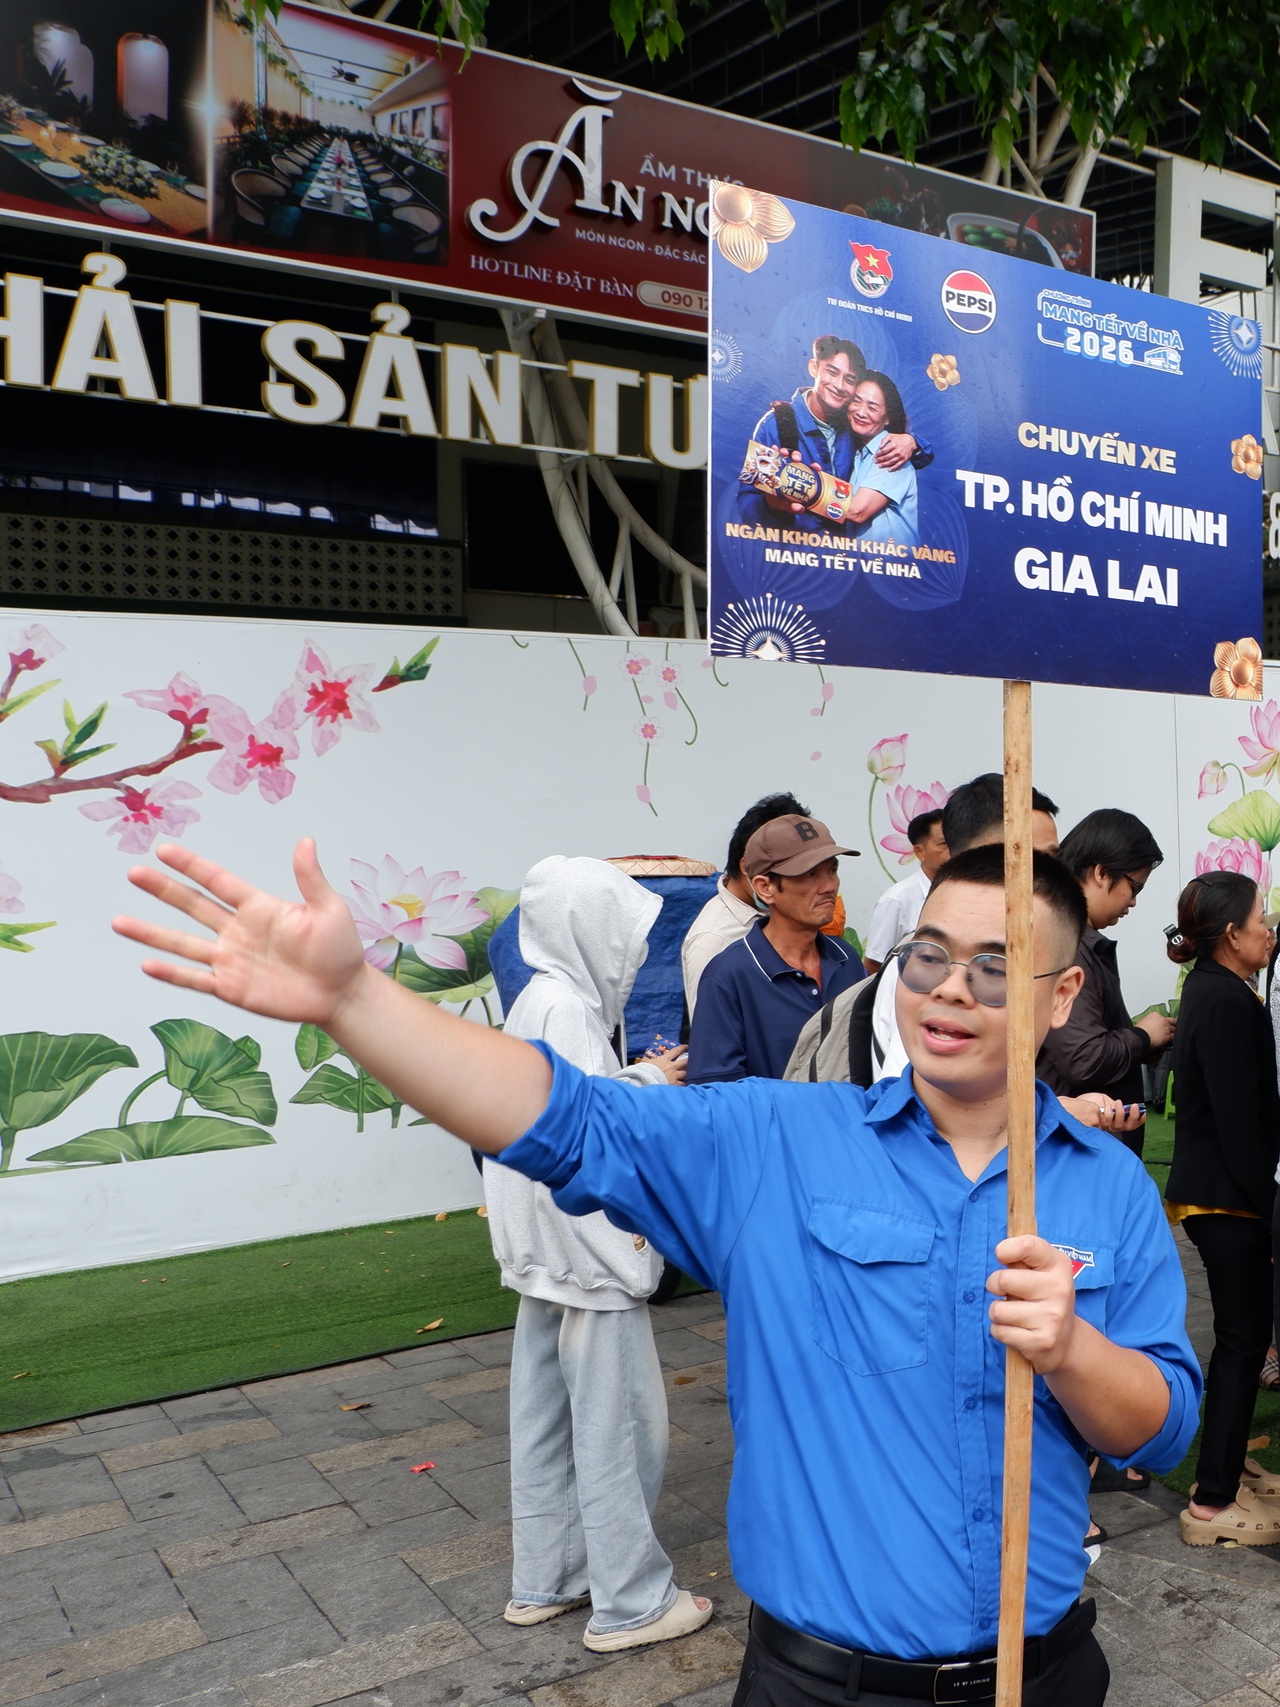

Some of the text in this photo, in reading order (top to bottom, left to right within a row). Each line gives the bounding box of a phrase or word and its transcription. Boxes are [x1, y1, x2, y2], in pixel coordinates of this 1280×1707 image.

[640, 153, 676, 182] ẨM
[608, 234, 645, 252] NGON
[470, 254, 634, 298] HOTLINE ĐẶT BÀN
[661, 290, 693, 308] 090
[945, 290, 993, 313] PEPSI
[1043, 302, 1184, 350] MANG TẾT VỀ NHÀ
[1064, 326, 1134, 367] 2026
[260, 301, 522, 447] SẢN
[1017, 421, 1177, 475] CHUYẾN XE
[787, 465, 815, 484] MANG
[787, 476, 811, 493] TẾT
[955, 469, 1228, 547] TP. HỒ CHÍ MINH
[725, 522, 957, 564] NGÀN KHOẢNH KHẮC VÀNG
[765, 548, 922, 580] MANG TẾT VỀ NHÀ
[1014, 546, 1179, 607] GIA LAI
[794, 821, 819, 842] B
